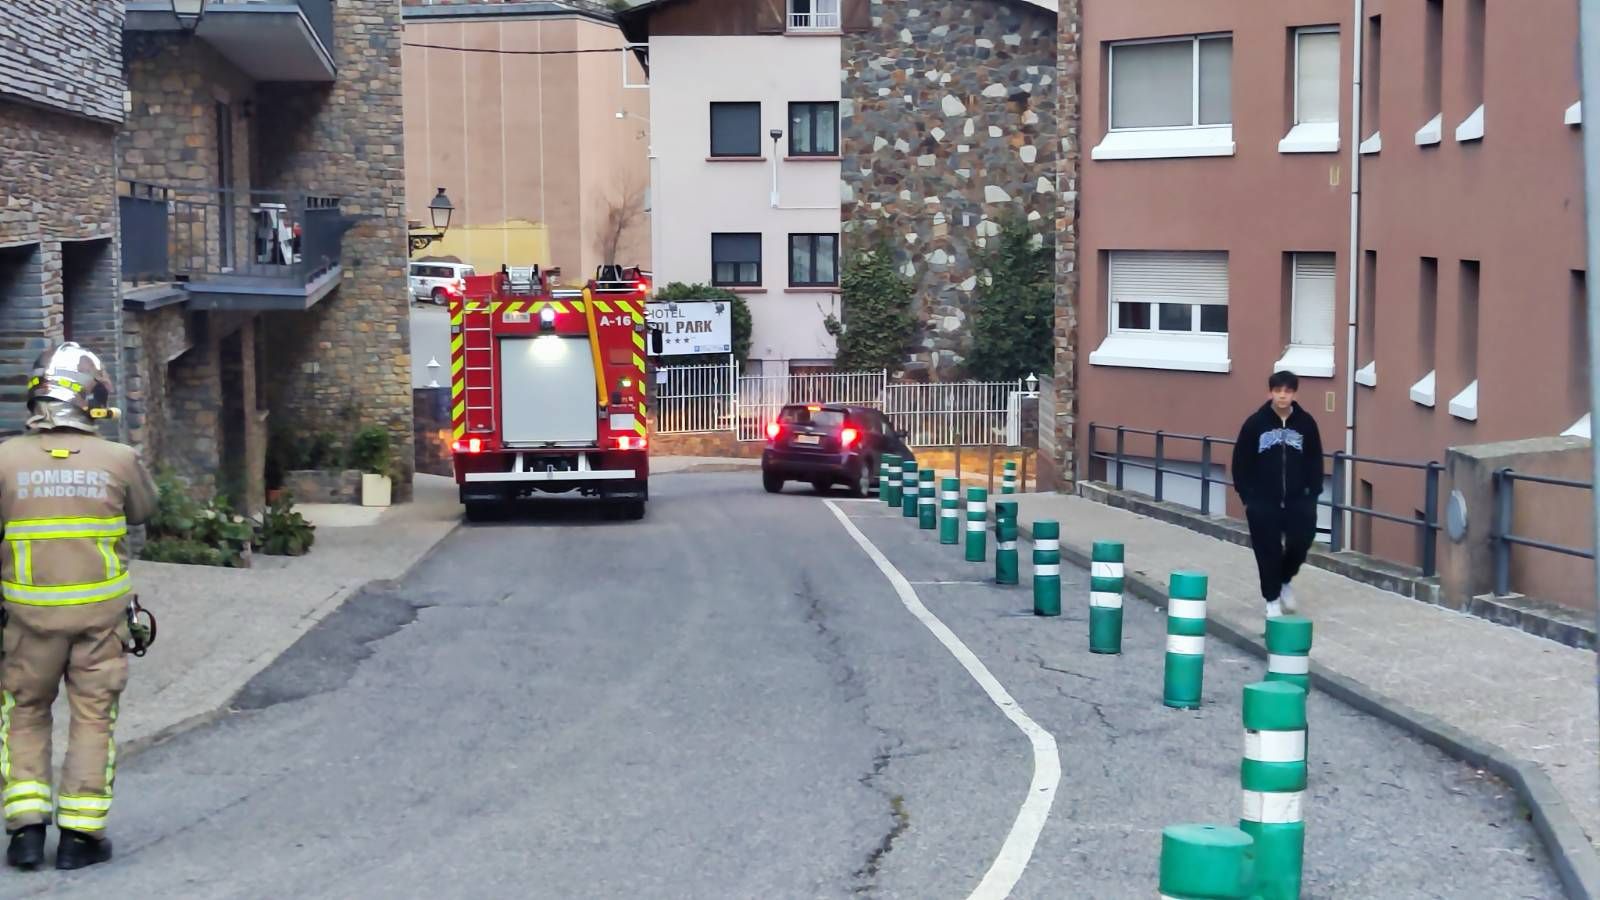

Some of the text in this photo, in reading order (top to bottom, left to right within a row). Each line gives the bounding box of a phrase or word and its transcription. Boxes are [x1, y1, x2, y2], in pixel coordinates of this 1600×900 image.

[600, 315, 631, 326] A-16
[676, 320, 712, 333] PARK
[17, 470, 110, 486] BOMBERS
